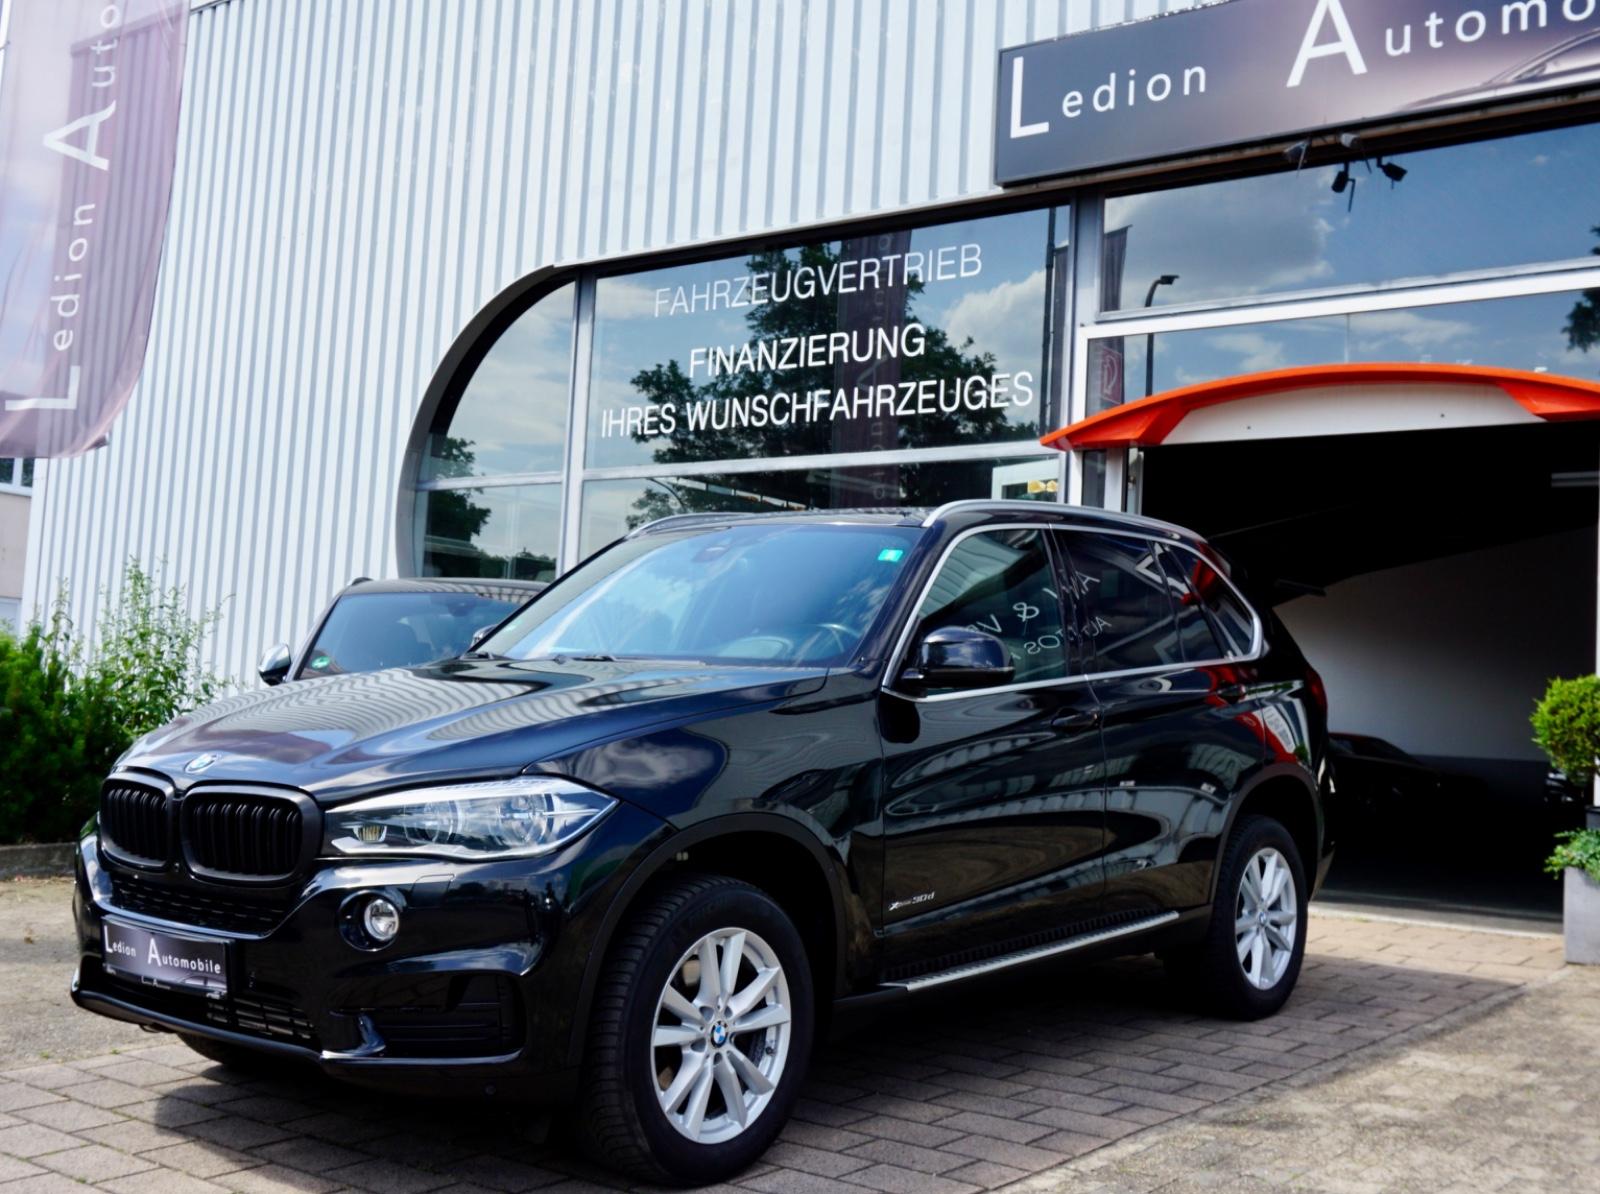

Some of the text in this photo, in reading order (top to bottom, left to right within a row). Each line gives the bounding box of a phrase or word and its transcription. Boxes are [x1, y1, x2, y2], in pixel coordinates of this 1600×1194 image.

[1010, 0, 1597, 139] Ledion Automo
[5, 204, 96, 411] Ledion
[654, 243, 982, 317] FAHRZEUGVERTRIEB
[689, 323, 925, 378] FINANZIERUNG
[601, 371, 1034, 438] IHRES WUNSCHFAHRZEUGES
[104, 925, 221, 974] Ledion Automobile
